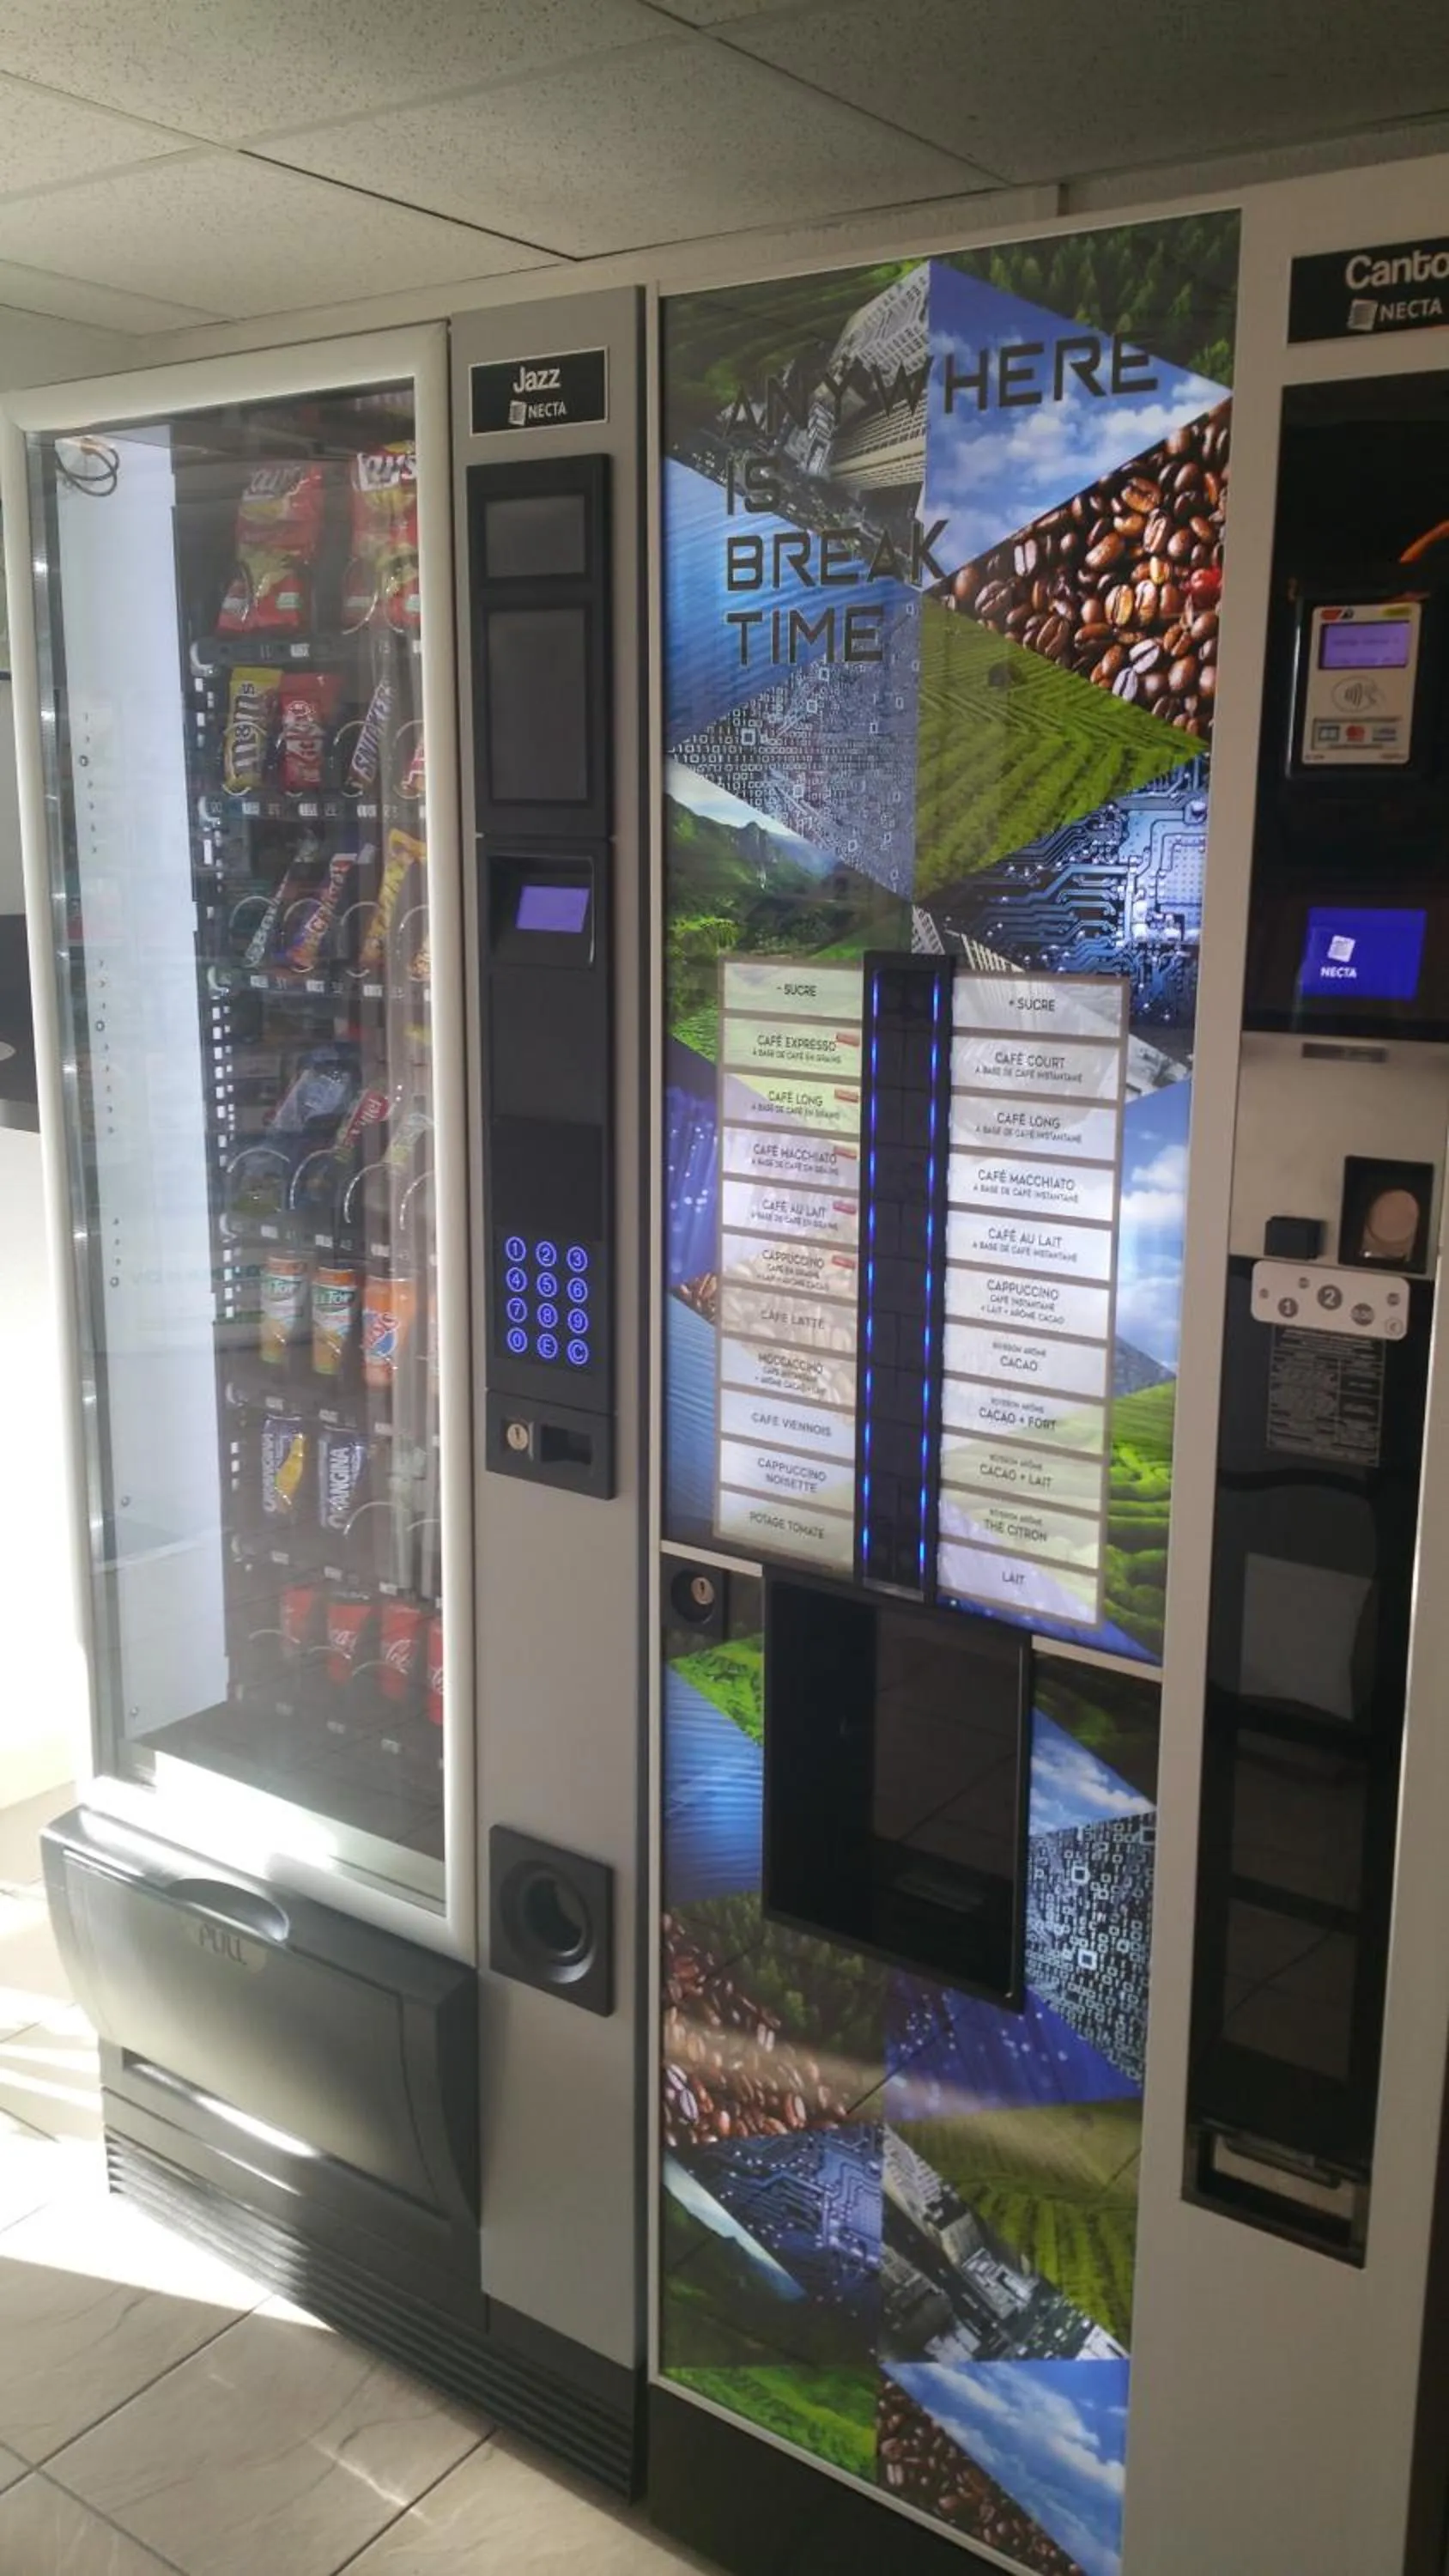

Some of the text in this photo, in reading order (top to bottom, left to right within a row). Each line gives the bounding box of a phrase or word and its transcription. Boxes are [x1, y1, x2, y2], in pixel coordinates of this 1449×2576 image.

[1380, 297, 1443, 321] NECTA
[513, 366, 561, 393] Jazz
[726, 332, 1159, 433] ANYWHERE
[528, 401, 567, 418] NECTA
[726, 458, 780, 515] IS
[726, 519, 950, 592] BREAK
[726, 605, 884, 667] TIME
[1320, 966, 1357, 979] NECTA
[784, 983, 818, 997] SUCRE
[1016, 997, 1056, 1012] SUCRE
[785, 1036, 837, 1052] EXPRESSO
[994, 1051, 1065, 1069] CAFÉ COURT
[796, 1093, 823, 1107] LONG
[1029, 1115, 1061, 1129] LONG
[780, 1147, 837, 1164] MACCHIATO
[978, 1168, 1075, 1191] CAFÉ MACCHIATO
[790, 1202, 803, 1214] AU
[805, 1205, 827, 1218] LAIT
[1019, 1232, 1034, 1244] AU
[1038, 1234, 1063, 1248] LAIT
[762, 1249, 825, 1270] CAPPUCCINO
[986, 1279, 1059, 1301] CAPPUCCINO
[791, 1316, 825, 1329] LATTE
[571, 1344, 584, 1359] C
[999, 1355, 1038, 1372] CACAO
[782, 1418, 832, 1437] VIENNOIS
[979, 1406, 1016, 1425] CACAO
[1028, 1417, 1058, 1431] FORT
[757, 1457, 827, 1482] CAPPUCCINO
[979, 1463, 1017, 1481] CACAO
[1028, 1474, 1053, 1488] LAIT
[766, 1473, 818, 1493] NOISETTE
[749, 1510, 825, 1540] POTAGE TOMATE
[1007, 1523, 1048, 1542] CITRON
[1001, 1571, 1025, 1585] LAIT
